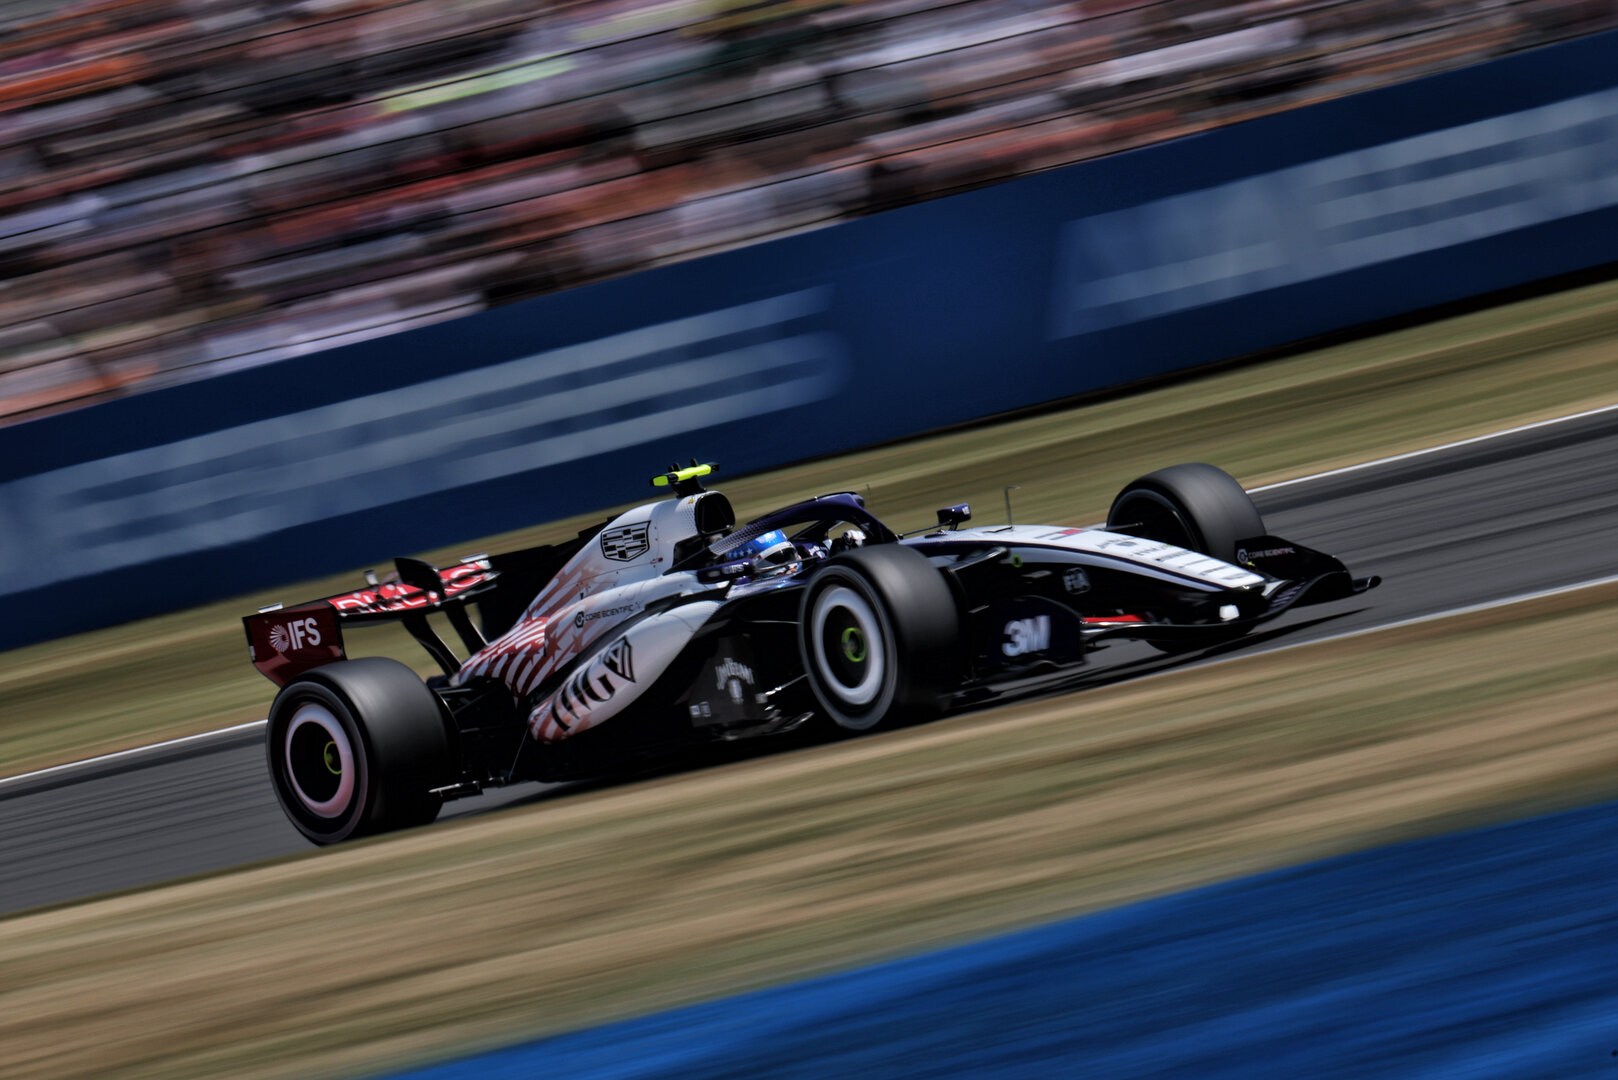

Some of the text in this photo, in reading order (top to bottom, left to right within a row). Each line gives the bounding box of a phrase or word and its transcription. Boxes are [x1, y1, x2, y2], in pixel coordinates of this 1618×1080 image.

[1248, 551, 1264, 559] CORE
[1064, 571, 1090, 593] FIA
[585, 611, 600, 621] CORE
[287, 617, 321, 650] IFS
[1002, 615, 1050, 657] 3M
